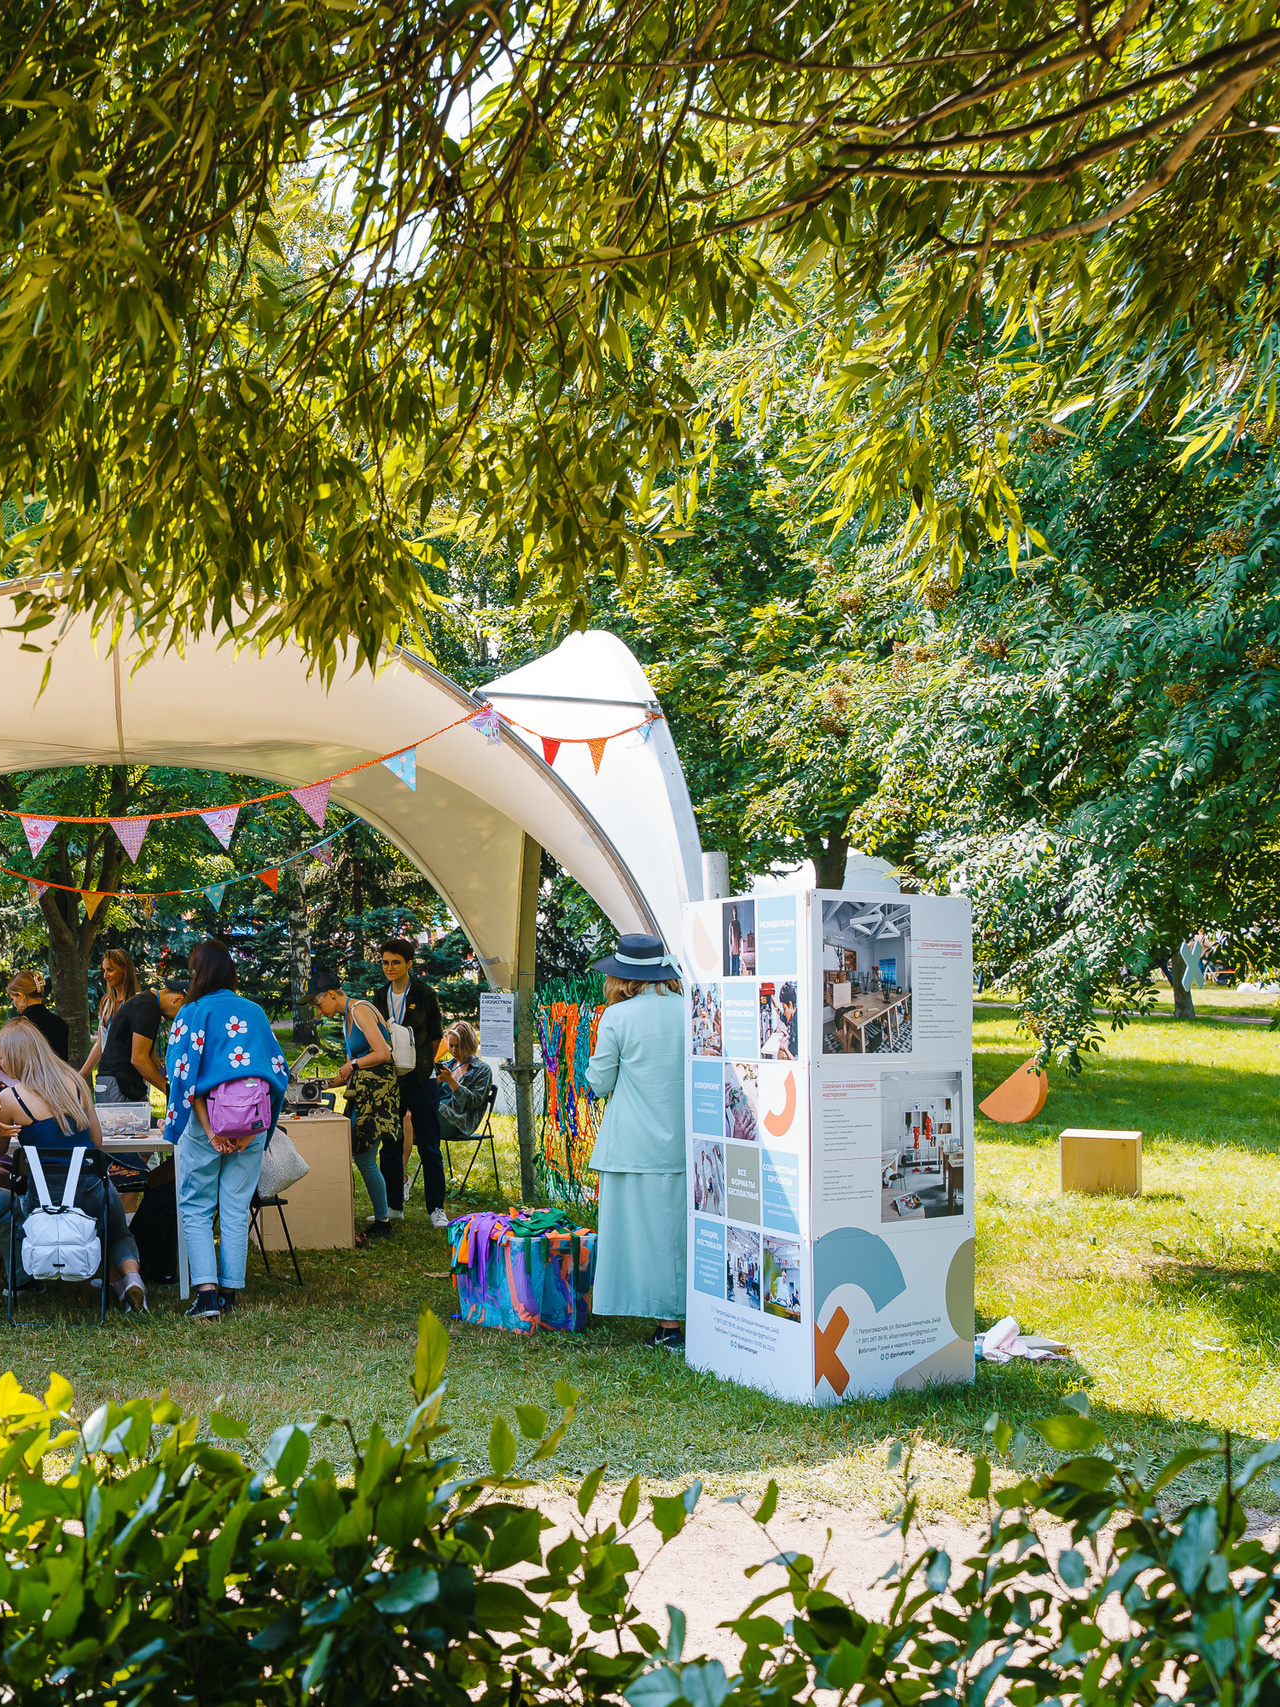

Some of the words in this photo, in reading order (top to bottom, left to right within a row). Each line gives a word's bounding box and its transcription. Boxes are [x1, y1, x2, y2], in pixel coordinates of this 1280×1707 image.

[737, 1168, 747, 1177] ВСЕ
[762, 1163, 798, 1176] СОВМЕСТНЫЕ
[730, 1178, 756, 1189] ФОРМАТЫ
[768, 1174, 793, 1186] ПРОЕКТЫ
[727, 1187, 759, 1200] БЕСПЛАТНЫЕ
[696, 1238, 723, 1251] ФЕСТИВАЛИ
[890, 1349, 915, 1359] @privetangar
